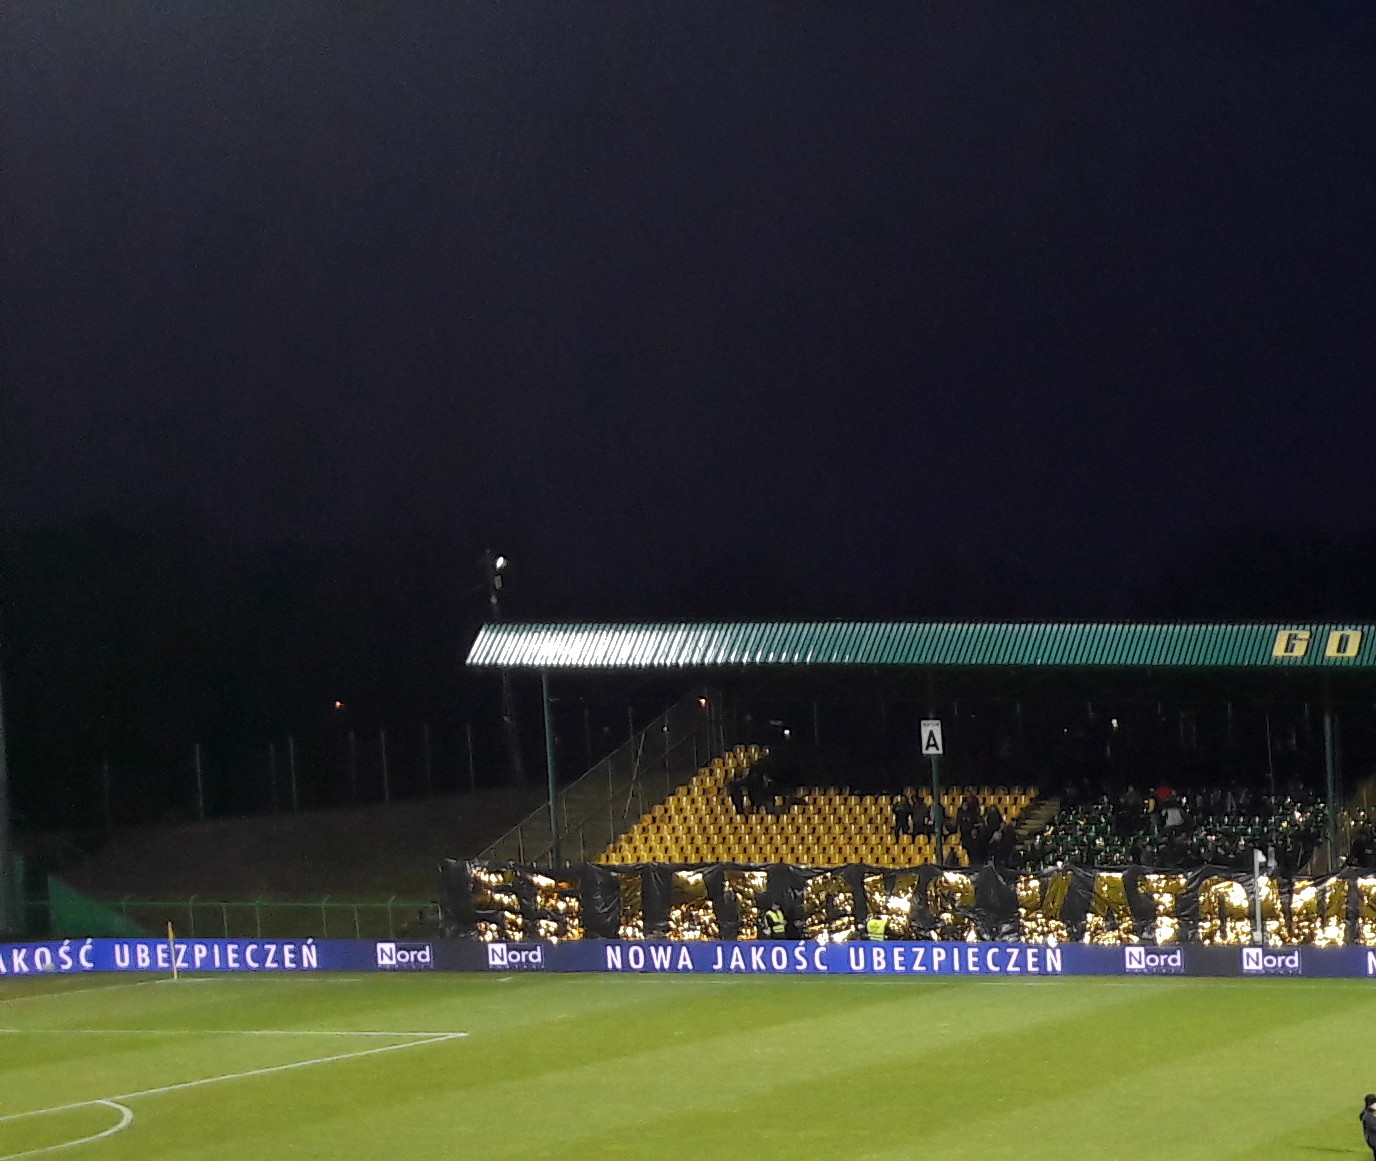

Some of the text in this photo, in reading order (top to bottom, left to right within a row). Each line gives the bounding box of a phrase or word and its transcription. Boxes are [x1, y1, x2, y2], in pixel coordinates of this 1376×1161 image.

[925, 729, 940, 751] A
[114, 938, 318, 973] UBEZPIECZEŃ
[376, 942, 431, 965] Nord
[487, 942, 542, 966] Nord
[606, 945, 693, 970] NOWA
[712, 940, 830, 971] JAKOŚĆ
[1124, 946, 1182, 969] Nord
[1242, 947, 1299, 972] Nord
